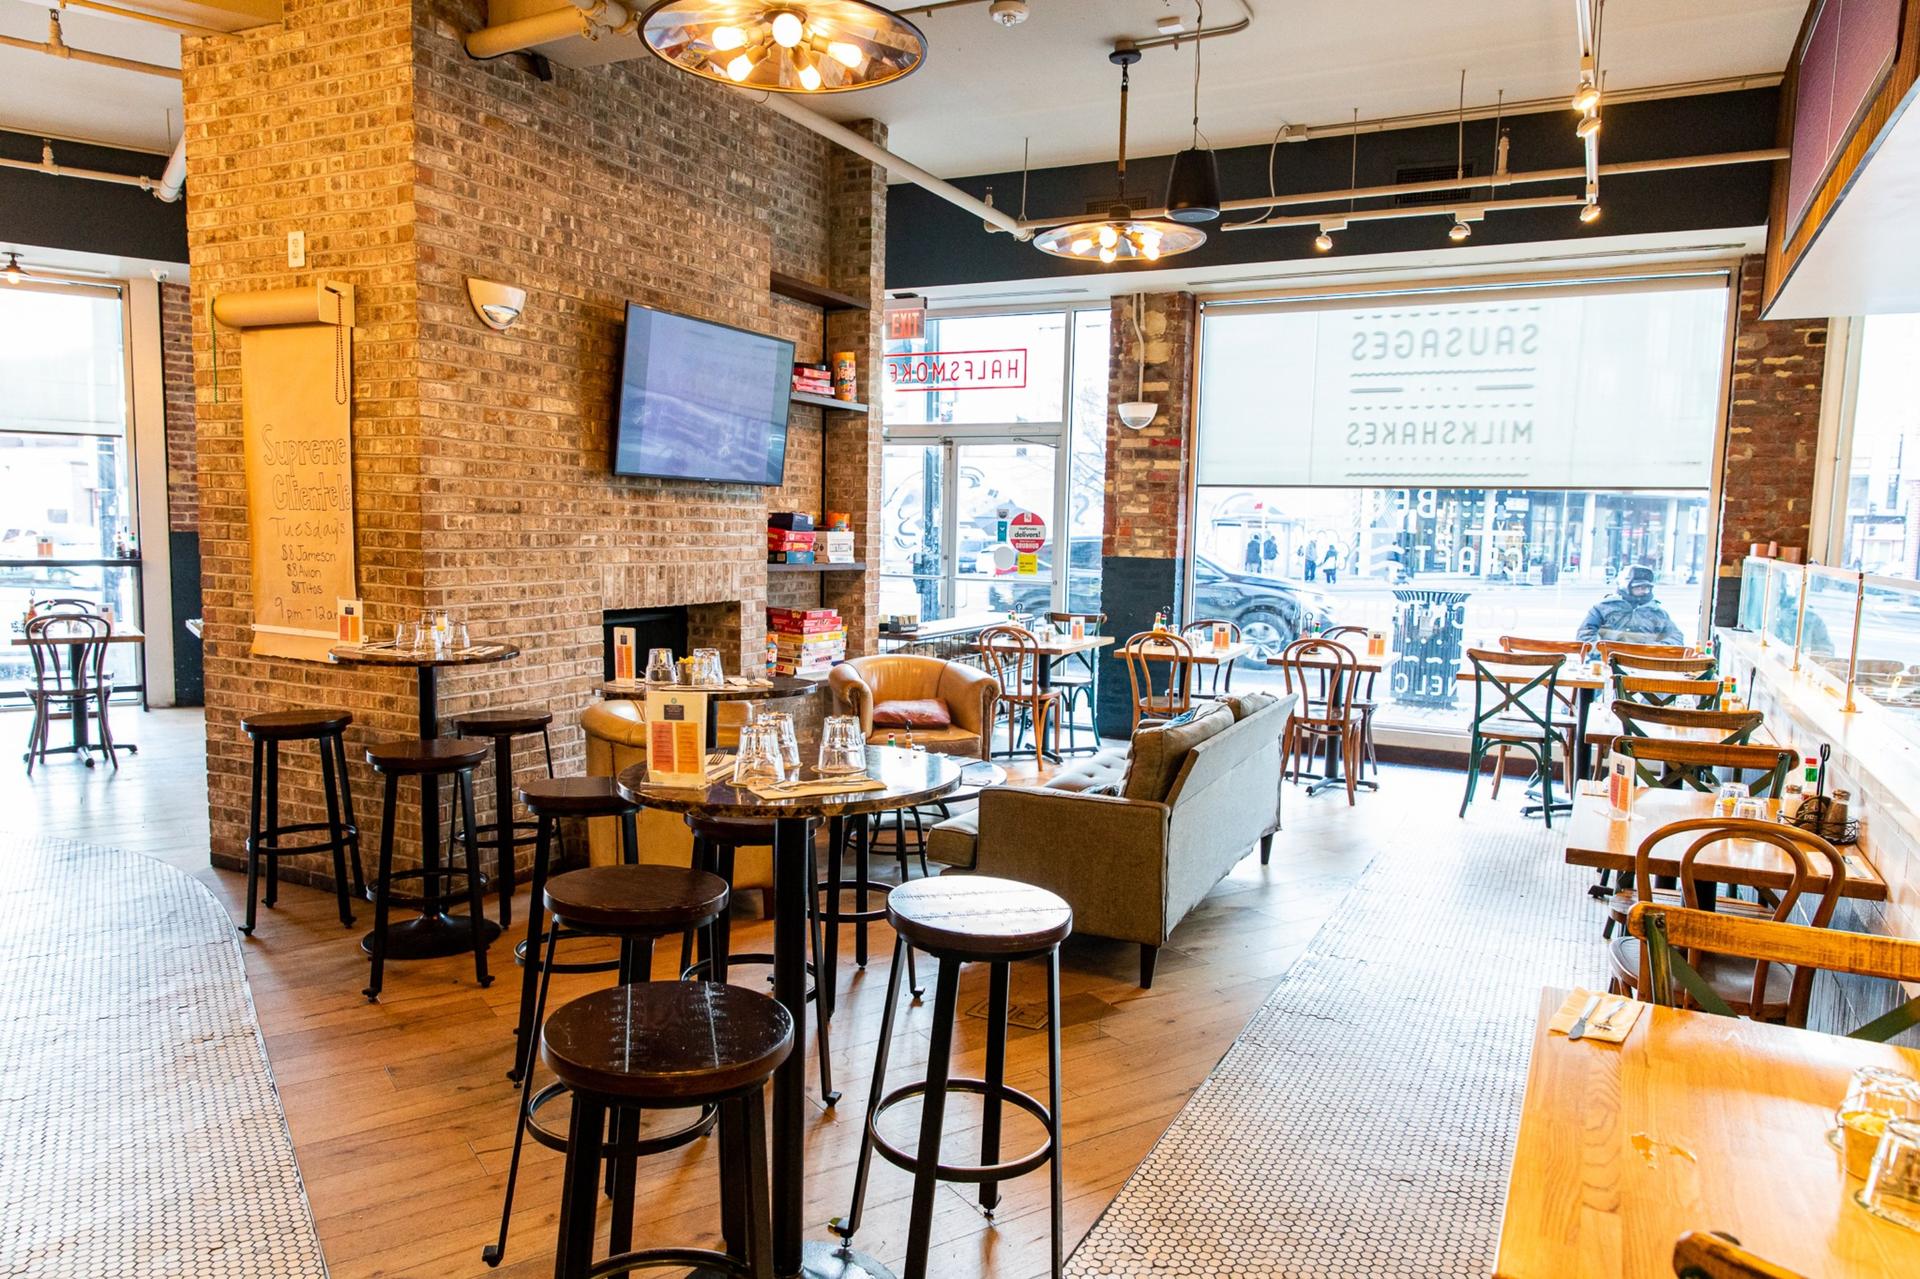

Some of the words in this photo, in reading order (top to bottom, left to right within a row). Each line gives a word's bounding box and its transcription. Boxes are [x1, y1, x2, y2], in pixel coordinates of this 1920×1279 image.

[891, 312, 920, 338] EXIT
[261, 424, 346, 477] Supreme
[272, 472, 352, 512] Clientele
[268, 517, 346, 544] Tuesdays
